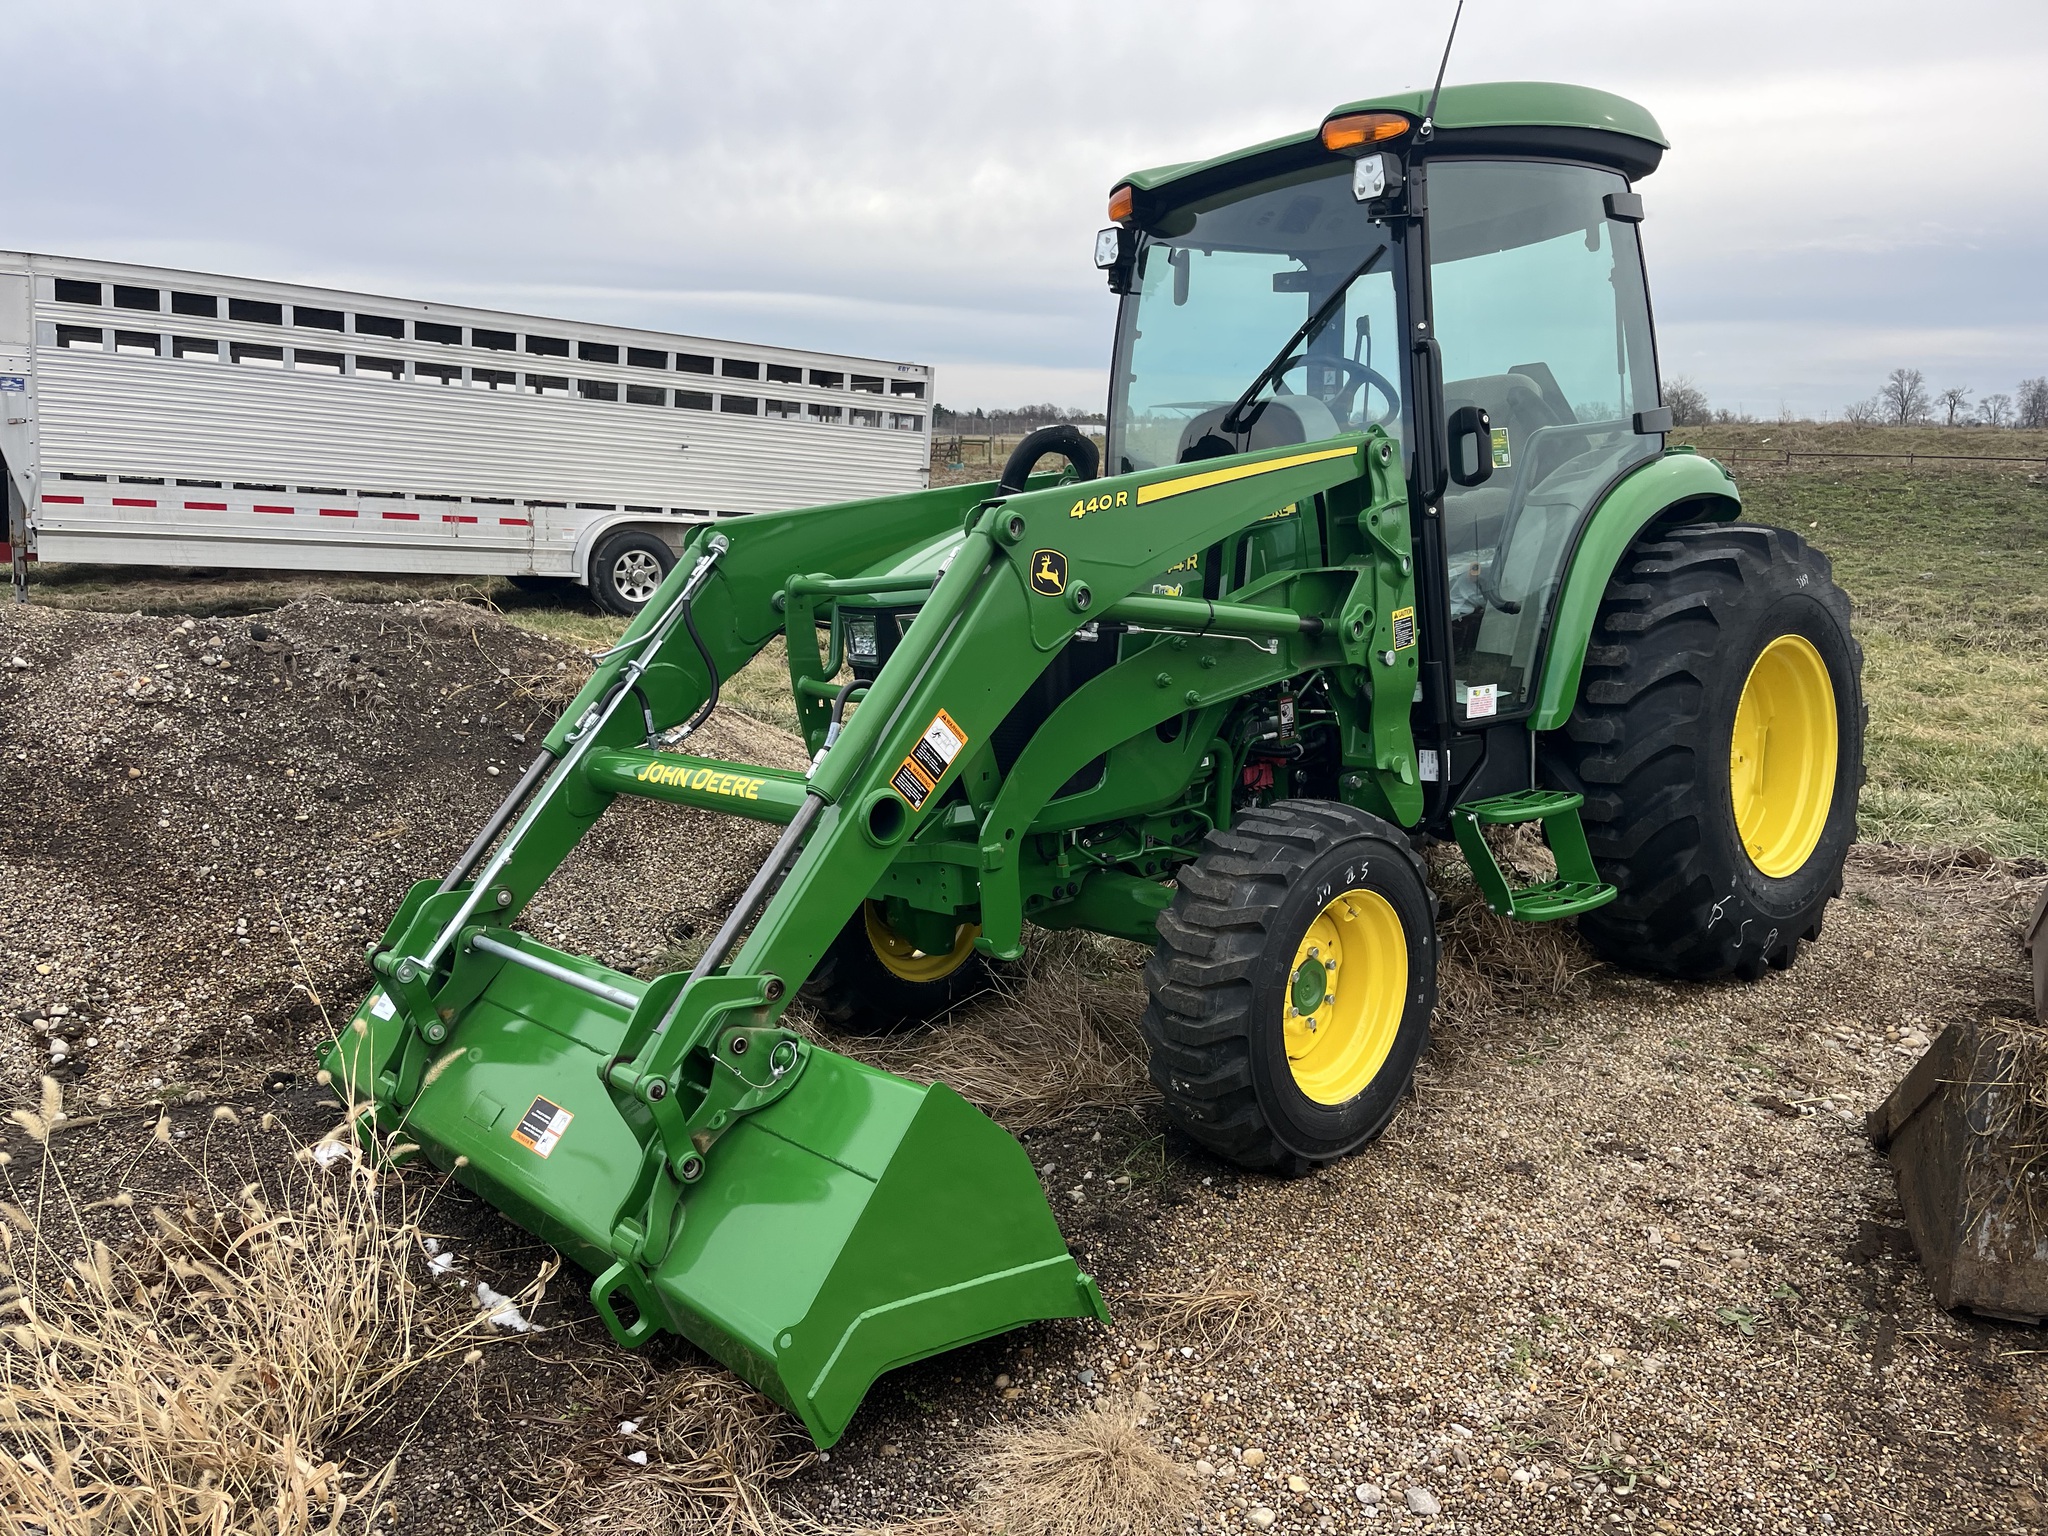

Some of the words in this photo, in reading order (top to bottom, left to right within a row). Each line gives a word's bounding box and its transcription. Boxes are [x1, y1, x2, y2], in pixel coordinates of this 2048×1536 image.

[946, 719, 964, 740] WARNING
[637, 761, 694, 788] JOHN
[691, 768, 766, 800] DEERE
[912, 765, 932, 788] WARNING
